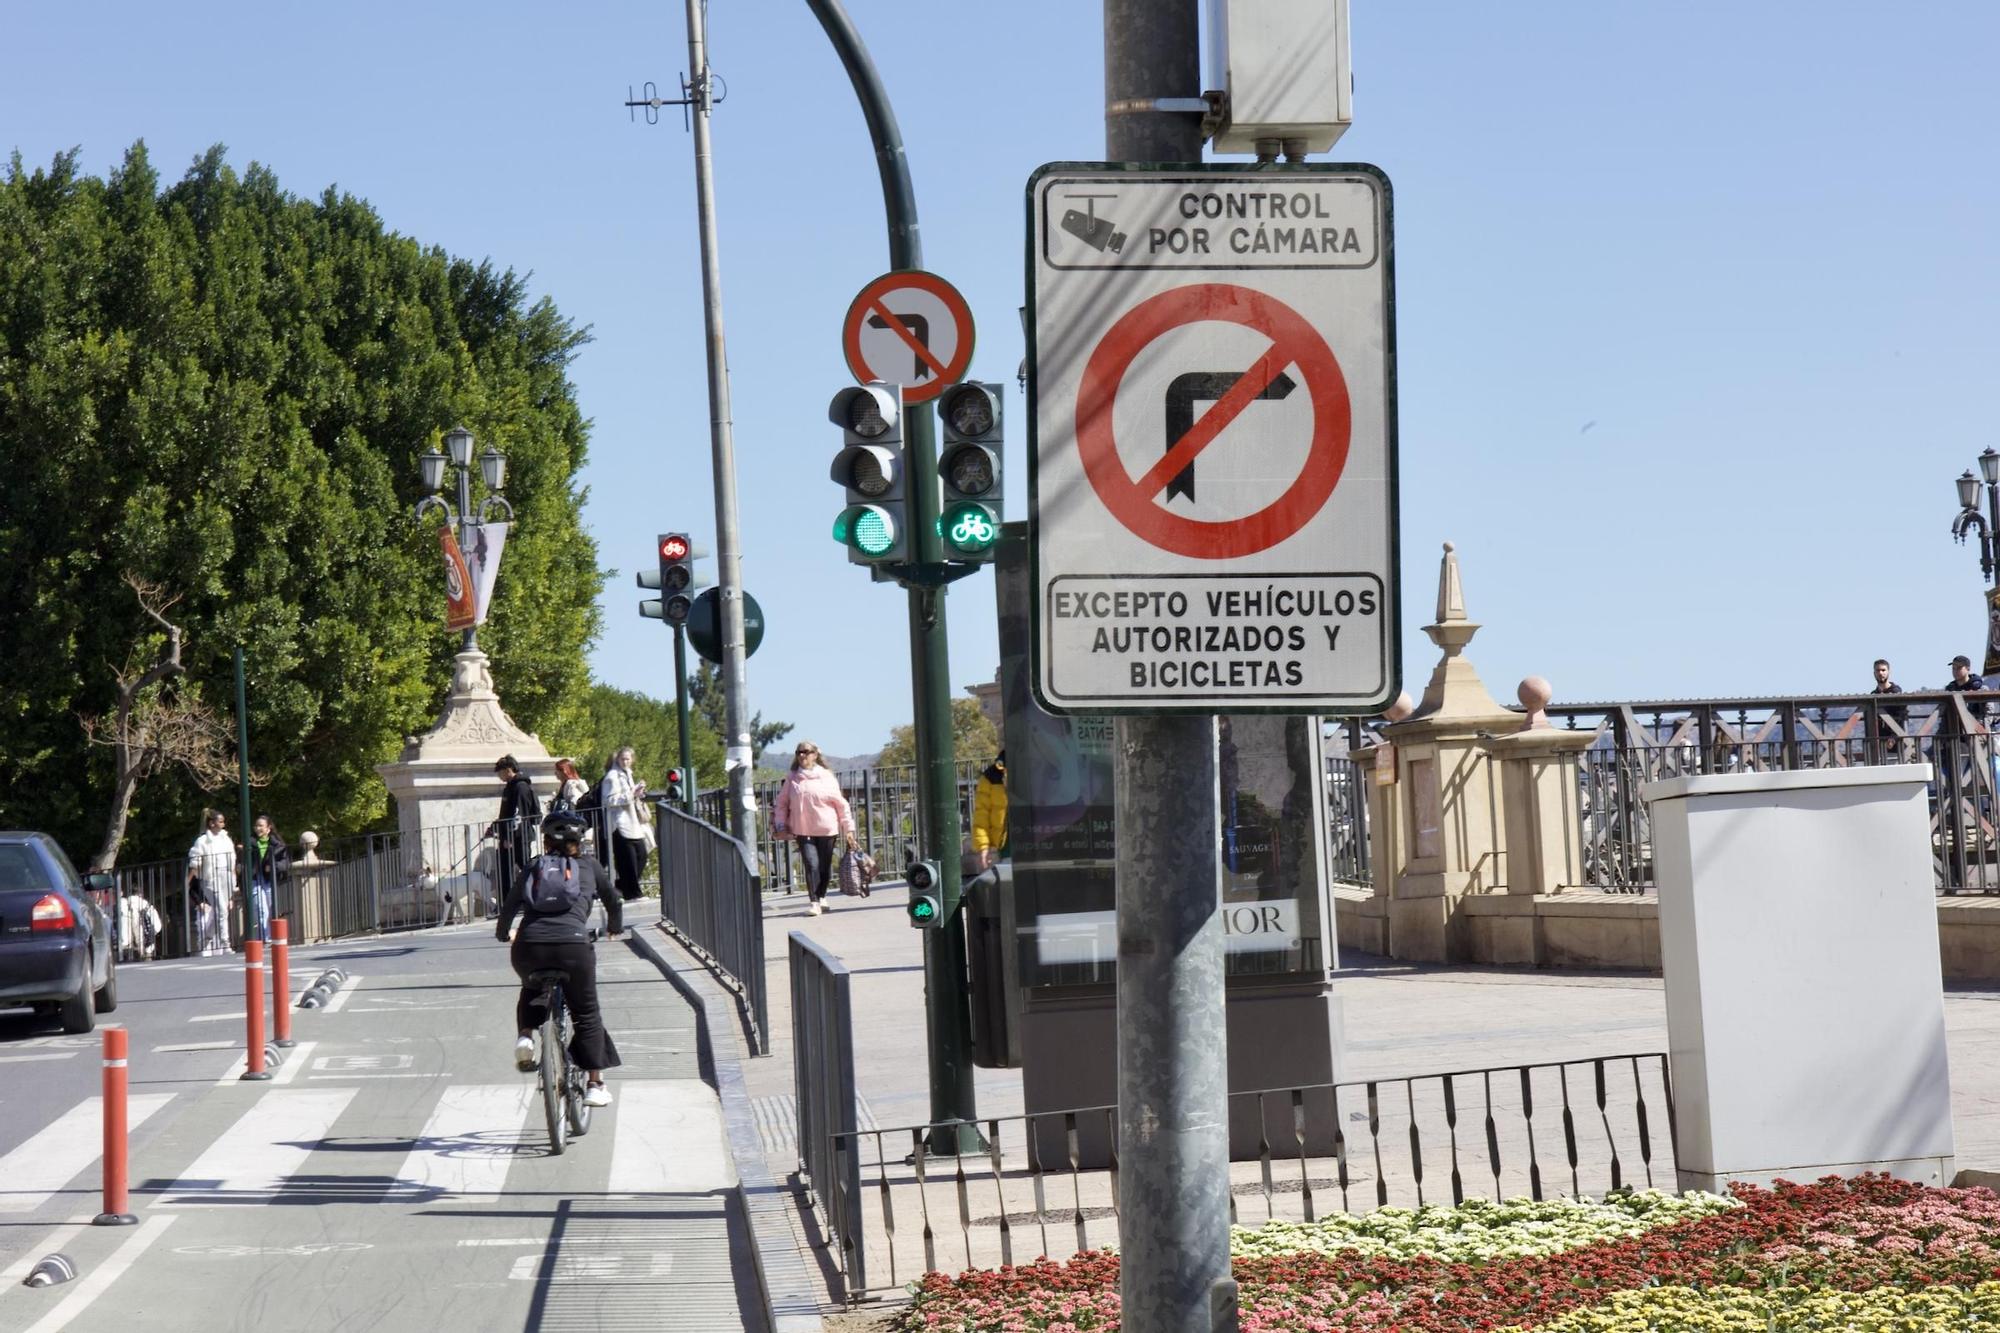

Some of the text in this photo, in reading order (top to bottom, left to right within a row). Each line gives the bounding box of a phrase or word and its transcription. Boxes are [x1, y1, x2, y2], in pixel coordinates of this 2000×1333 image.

[1179, 192, 1330, 219] CONTROL
[1149, 221, 1361, 254] POR CÁMARA
[1055, 584, 1377, 618] EXCEPTO VEHÍCULOS
[1091, 625, 1341, 653] AUTORIZADOS Y
[1130, 660, 1303, 688] BICICLETAS
[1223, 906, 1286, 935] IOR
